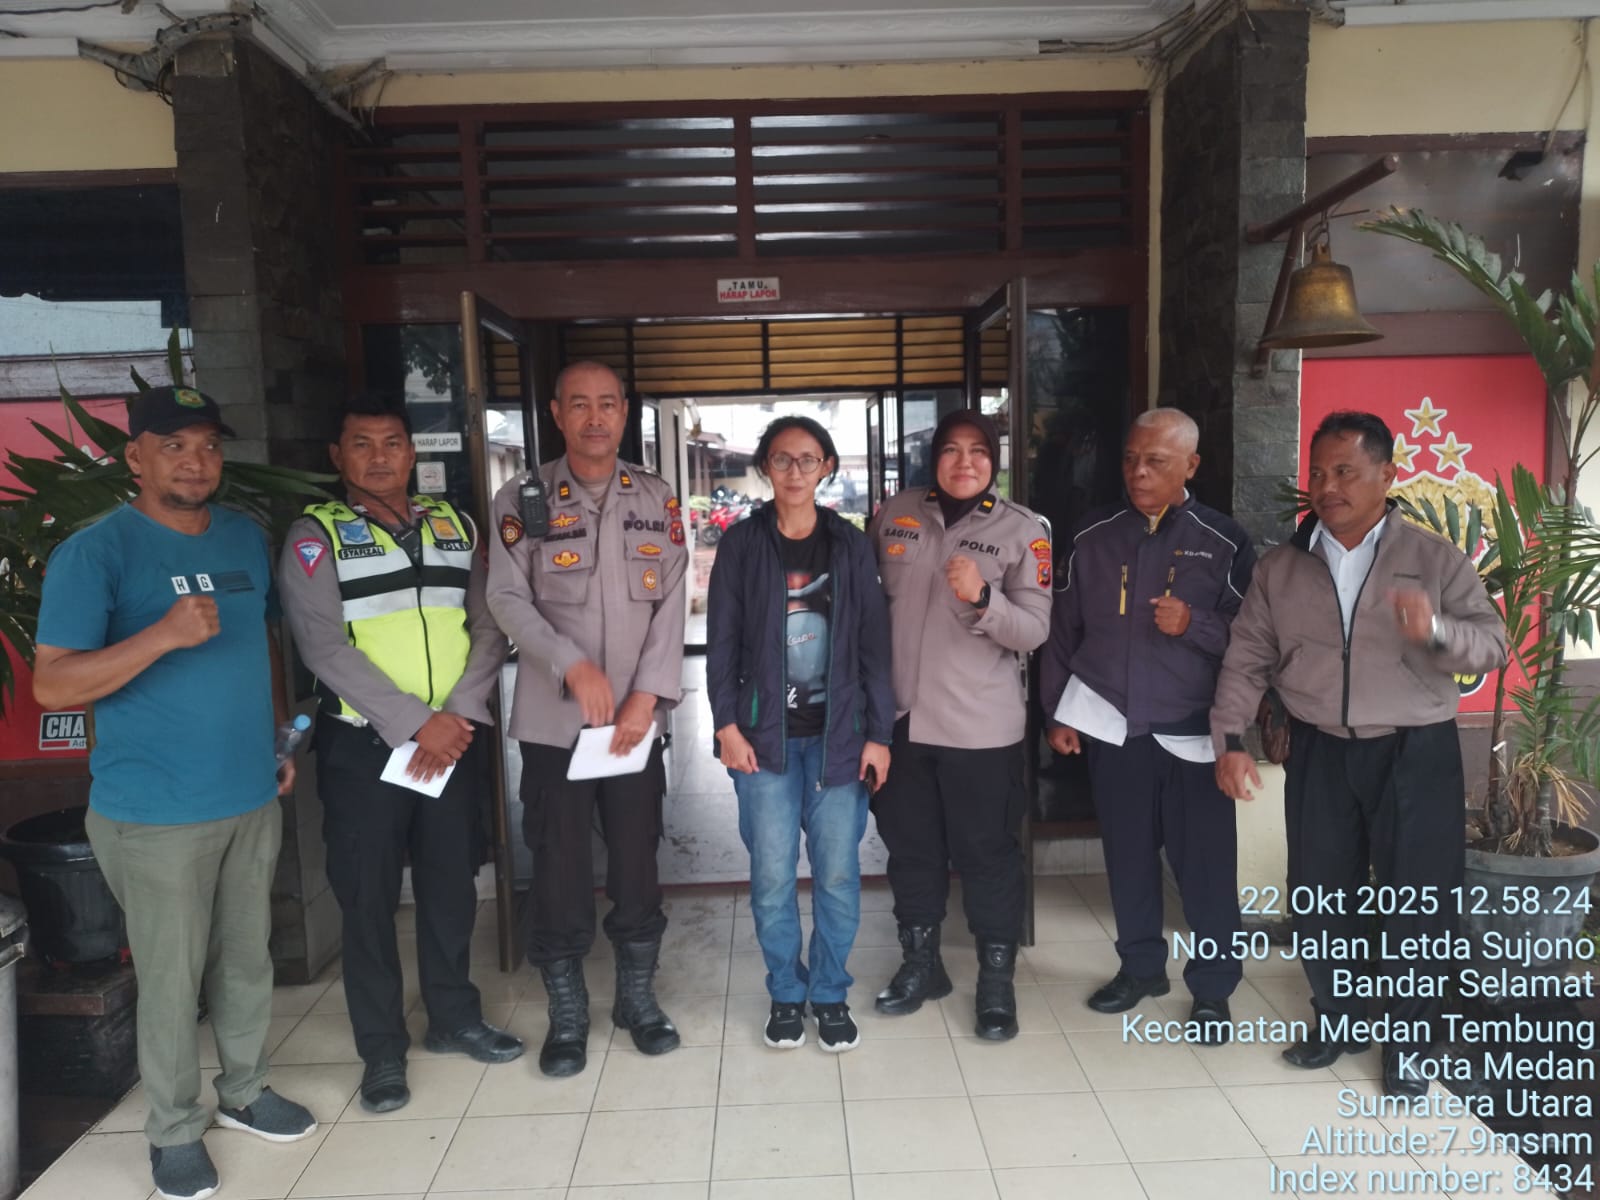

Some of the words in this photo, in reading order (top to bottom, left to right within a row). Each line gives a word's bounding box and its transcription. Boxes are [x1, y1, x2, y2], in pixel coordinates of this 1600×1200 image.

[719, 290, 748, 300] HARAP
[750, 289, 777, 299] LAPOR
[417, 438, 437, 447] HARAP
[438, 437, 459, 447] LAPOR
[623, 519, 665, 534] POLRI
[884, 528, 920, 542] SAGITA
[959, 539, 1000, 557] POLRI
[46, 715, 86, 738] CHA
